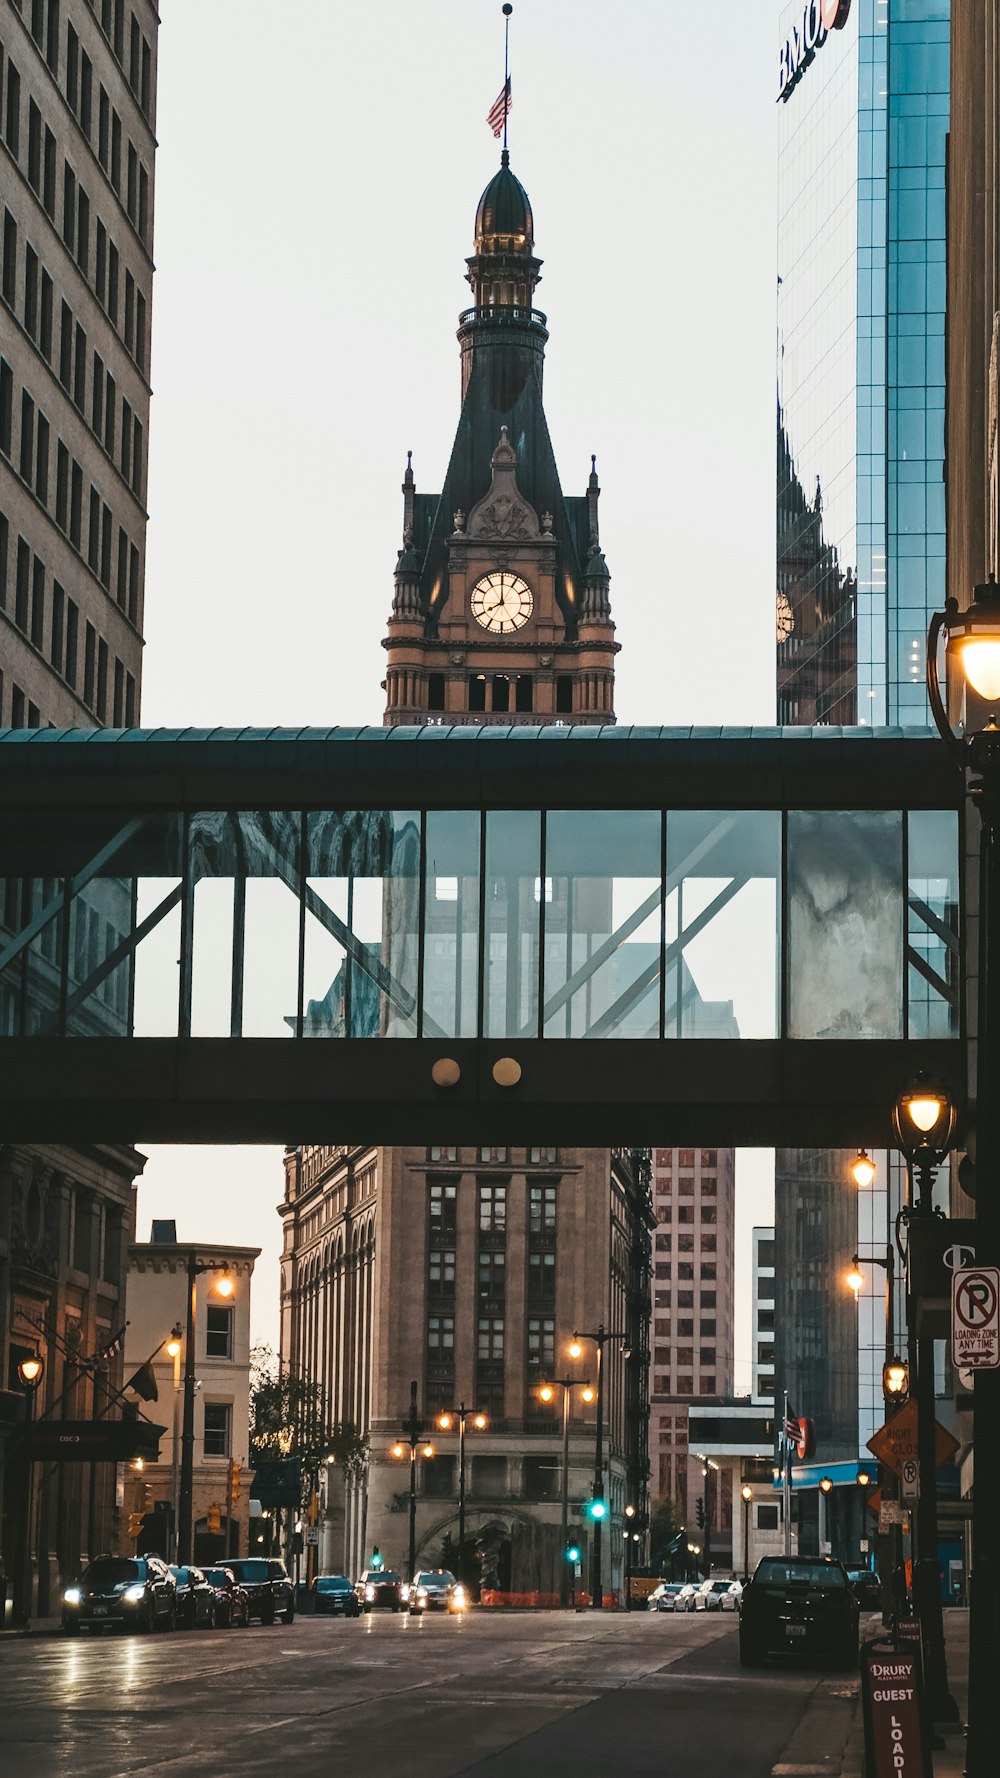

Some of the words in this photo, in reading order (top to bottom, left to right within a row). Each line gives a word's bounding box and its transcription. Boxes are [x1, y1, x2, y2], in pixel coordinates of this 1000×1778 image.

[955, 1330, 981, 1340] LOADING
[982, 1328, 998, 1339] ZONE
[959, 1340, 976, 1349] ANY
[977, 1339, 994, 1349] TIME
[870, 1664, 912, 1676] DRURY
[873, 1689, 914, 1702] GUEST
